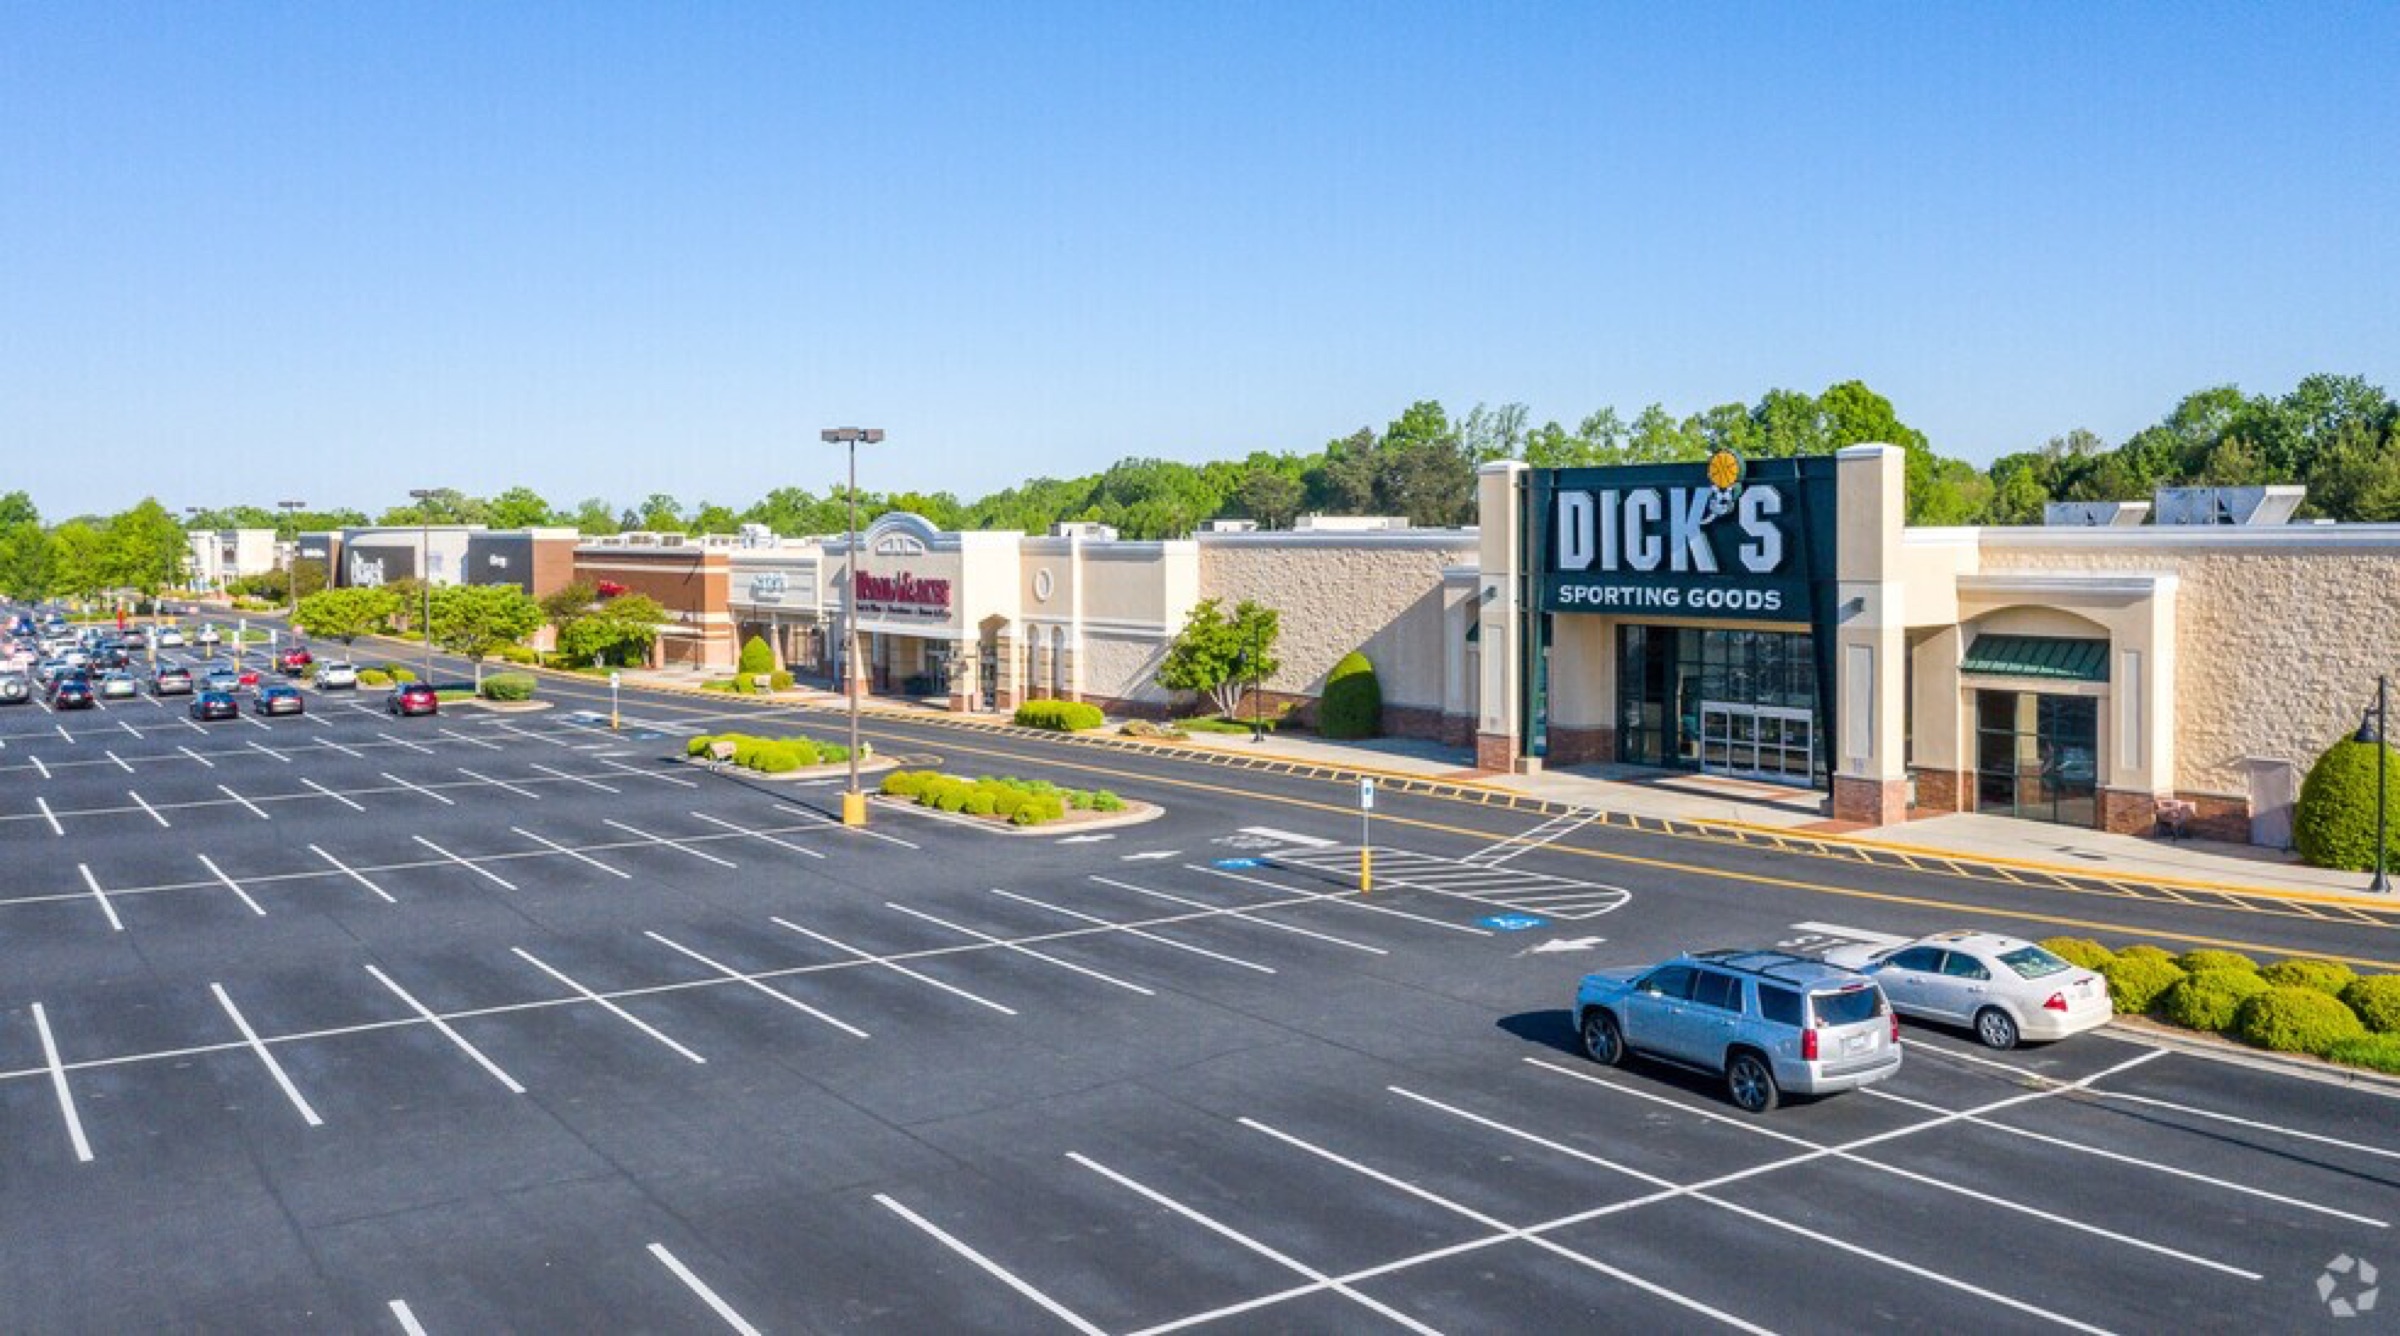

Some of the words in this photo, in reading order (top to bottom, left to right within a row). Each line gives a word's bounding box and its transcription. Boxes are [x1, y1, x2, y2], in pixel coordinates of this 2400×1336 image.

[1557, 484, 1783, 574] DICK'S
[1558, 584, 1681, 607] SPORTING
[1686, 587, 1782, 611] GOODS
